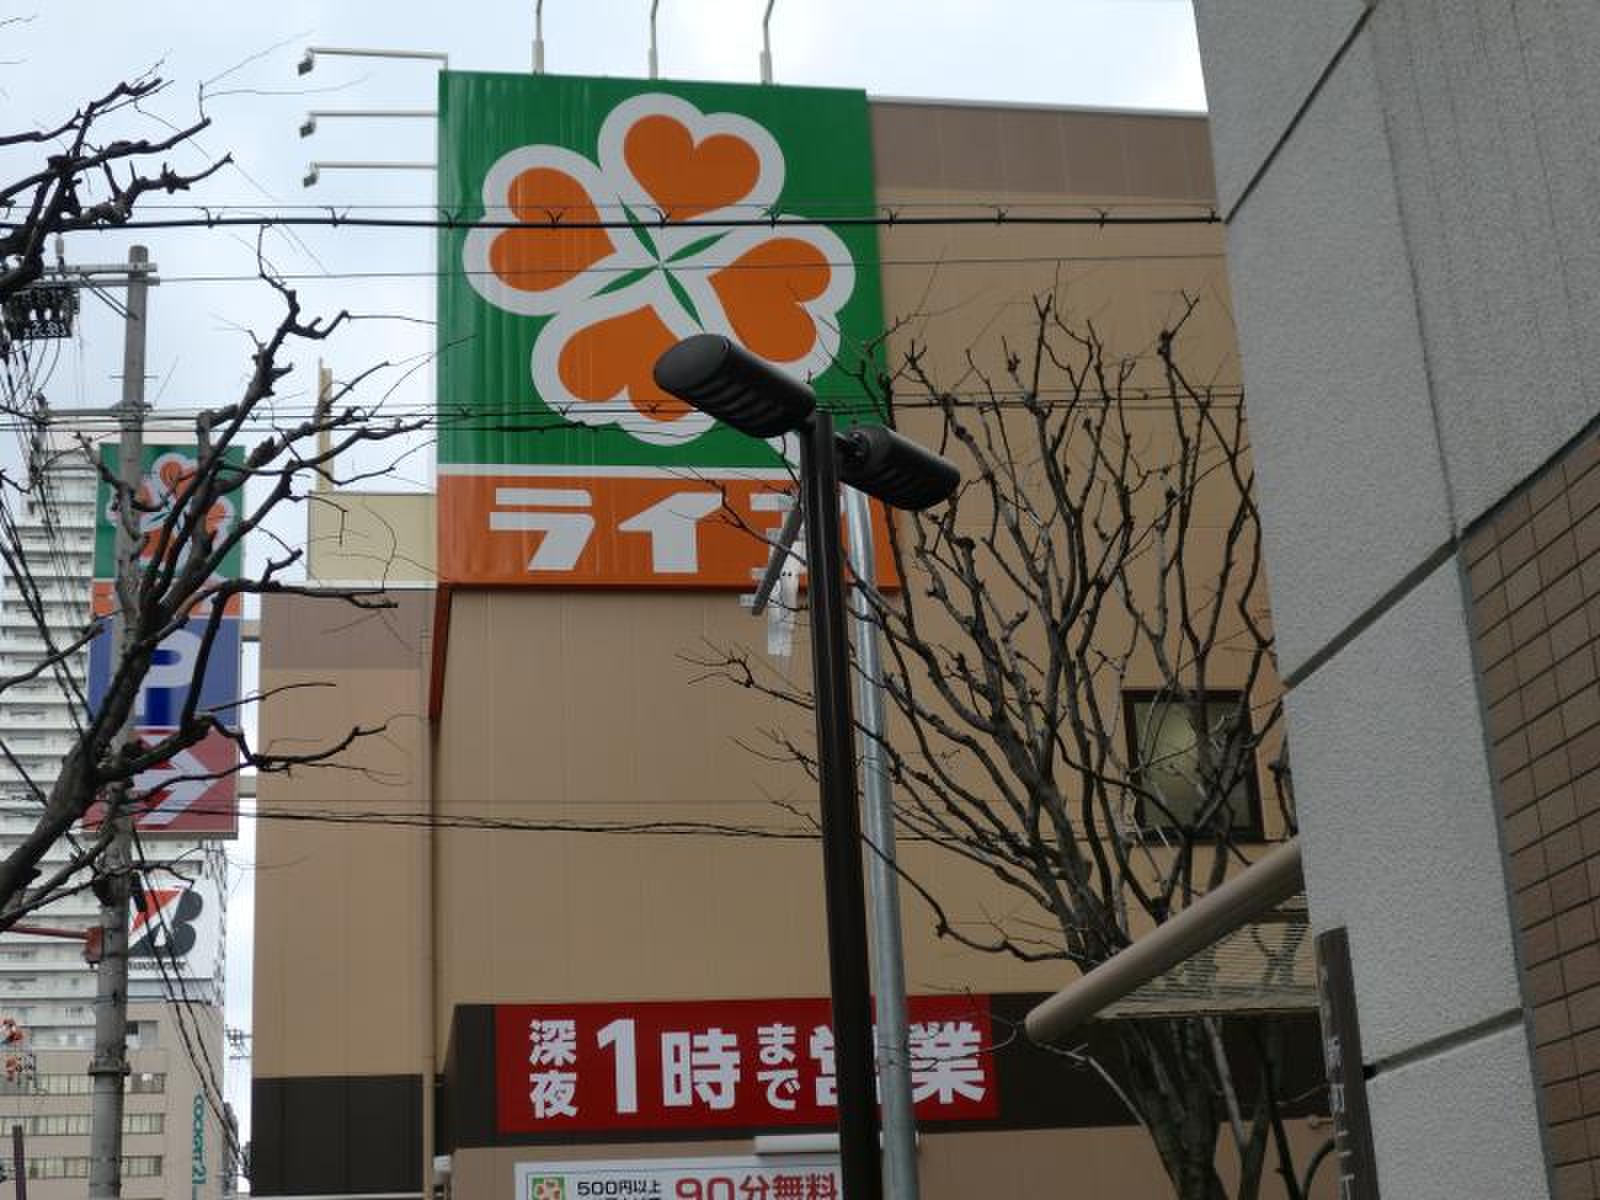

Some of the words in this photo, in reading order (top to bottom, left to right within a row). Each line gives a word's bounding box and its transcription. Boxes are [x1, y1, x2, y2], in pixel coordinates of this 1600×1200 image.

[577, 1179, 662, 1196] 500円以上
[675, 1173, 838, 1200] 90分無料
